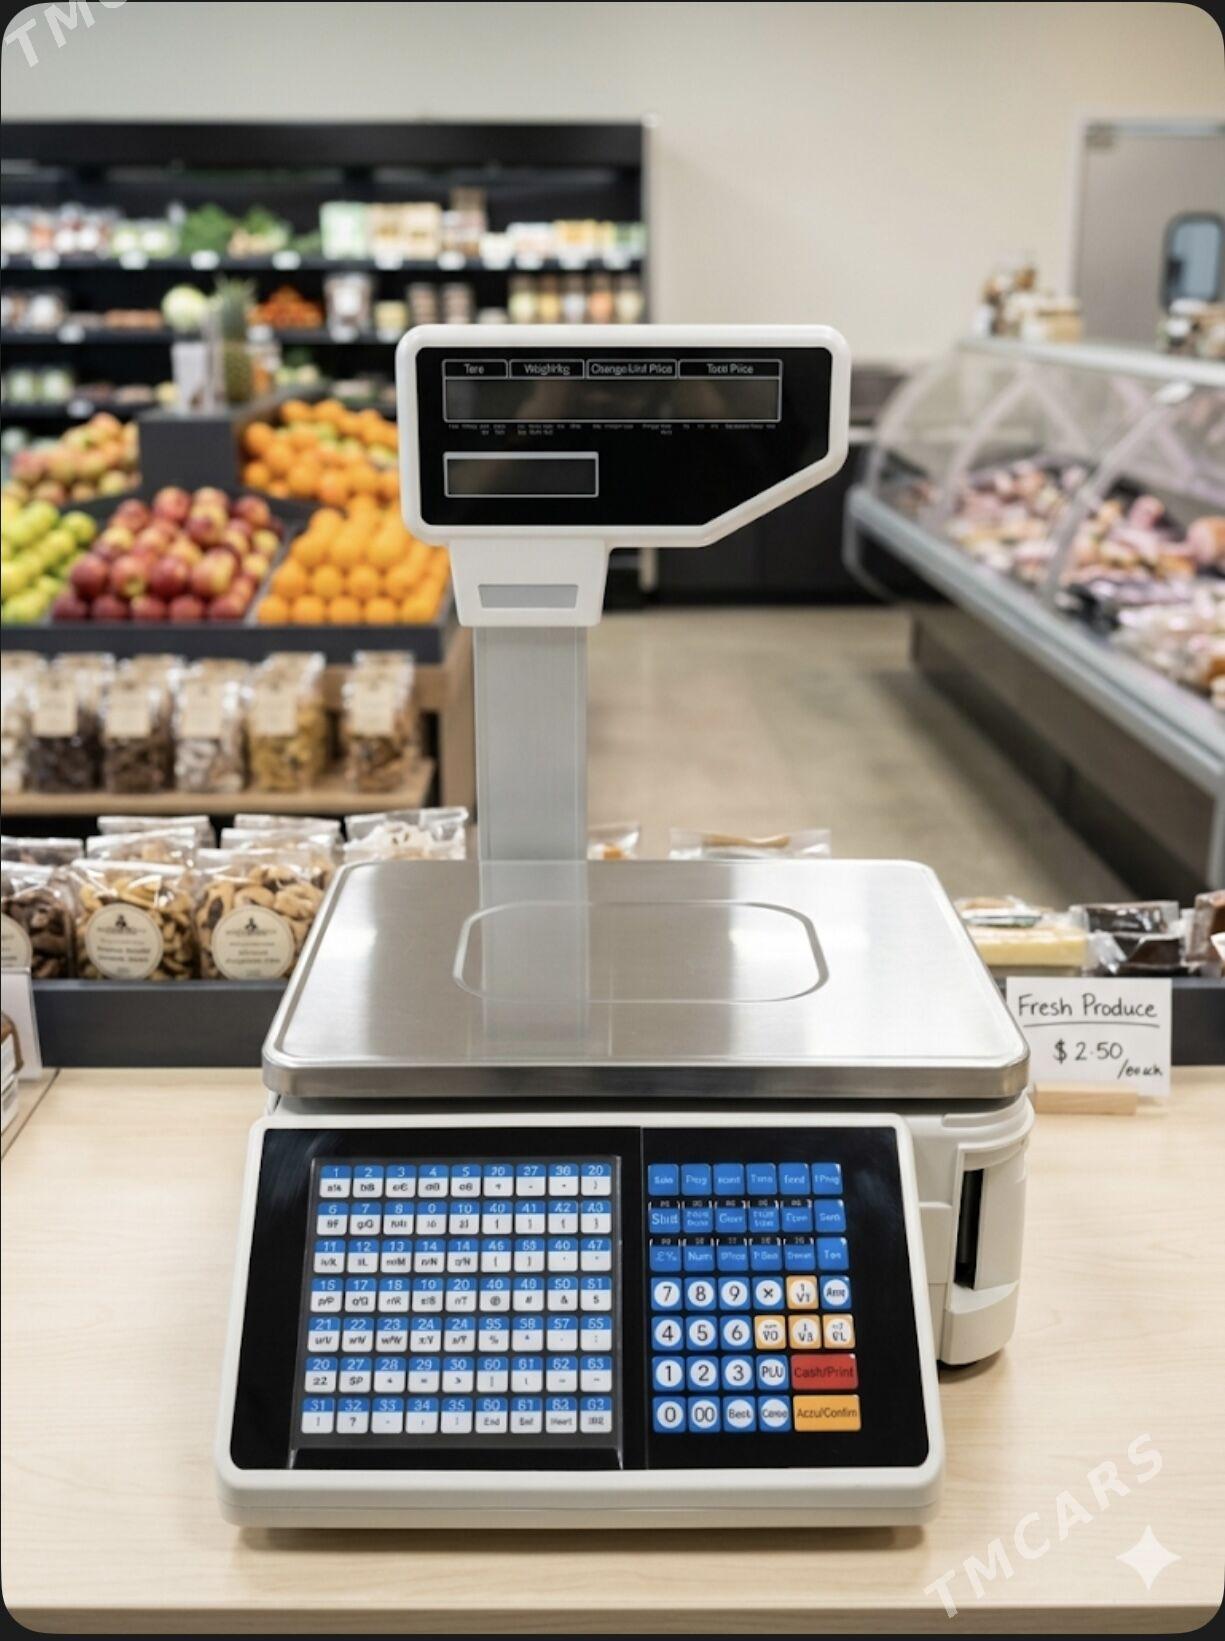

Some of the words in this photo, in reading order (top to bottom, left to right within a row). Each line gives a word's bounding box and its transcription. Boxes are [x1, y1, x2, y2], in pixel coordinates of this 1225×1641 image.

[1018, 993, 1073, 1016] Fresh
[1082, 992, 1158, 1018] Produce
[333, 1167, 340, 1178] 1
[364, 1167, 373, 1177] 2
[397, 1167, 405, 1177] 3
[429, 1167, 437, 1177] 4
[462, 1166, 470, 1177] 5
[588, 1165, 604, 1176] 20
[329, 1204, 336, 1214] 6
[362, 1204, 370, 1214] 7
[395, 1203, 403, 1214] 8
[459, 1204, 472, 1214] 10
[521, 1203, 537, 1213] 41
[324, 1242, 336, 1252] 11
[357, 1241, 371, 1252] 12
[391, 1241, 405, 1252] 13
[424, 1242, 436, 1252] 14
[587, 1241, 603, 1251] 47
[354, 1280, 368, 1290] 17
[453, 1279, 469, 1290] 20
[587, 1278, 602, 1289] 51
[663, 1286, 673, 1301] 7
[695, 1286, 706, 1301] 8
[729, 1286, 740, 1301] 9
[316, 1319, 331, 1329] 21
[350, 1319, 366, 1329] 22
[384, 1318, 400, 1329] 23
[418, 1318, 434, 1329] 24
[554, 1318, 570, 1329] 57
[662, 1326, 674, 1341] 4
[697, 1325, 708, 1341] 5
[732, 1325, 743, 1341] 6
[313, 1359, 329, 1370] 20
[347, 1359, 364, 1370] 27
[519, 1358, 533, 1370] 61
[554, 1358, 570, 1370] 62
[665, 1366, 672, 1381] 1
[698, 1365, 709, 1381] 2
[733, 1365, 744, 1381] 3
[310, 1400, 324, 1410] 31
[345, 1400, 361, 1410] 32
[665, 1407, 676, 1422] 0
[695, 1407, 715, 1422] 00
[350, 1416, 357, 1426] ?
